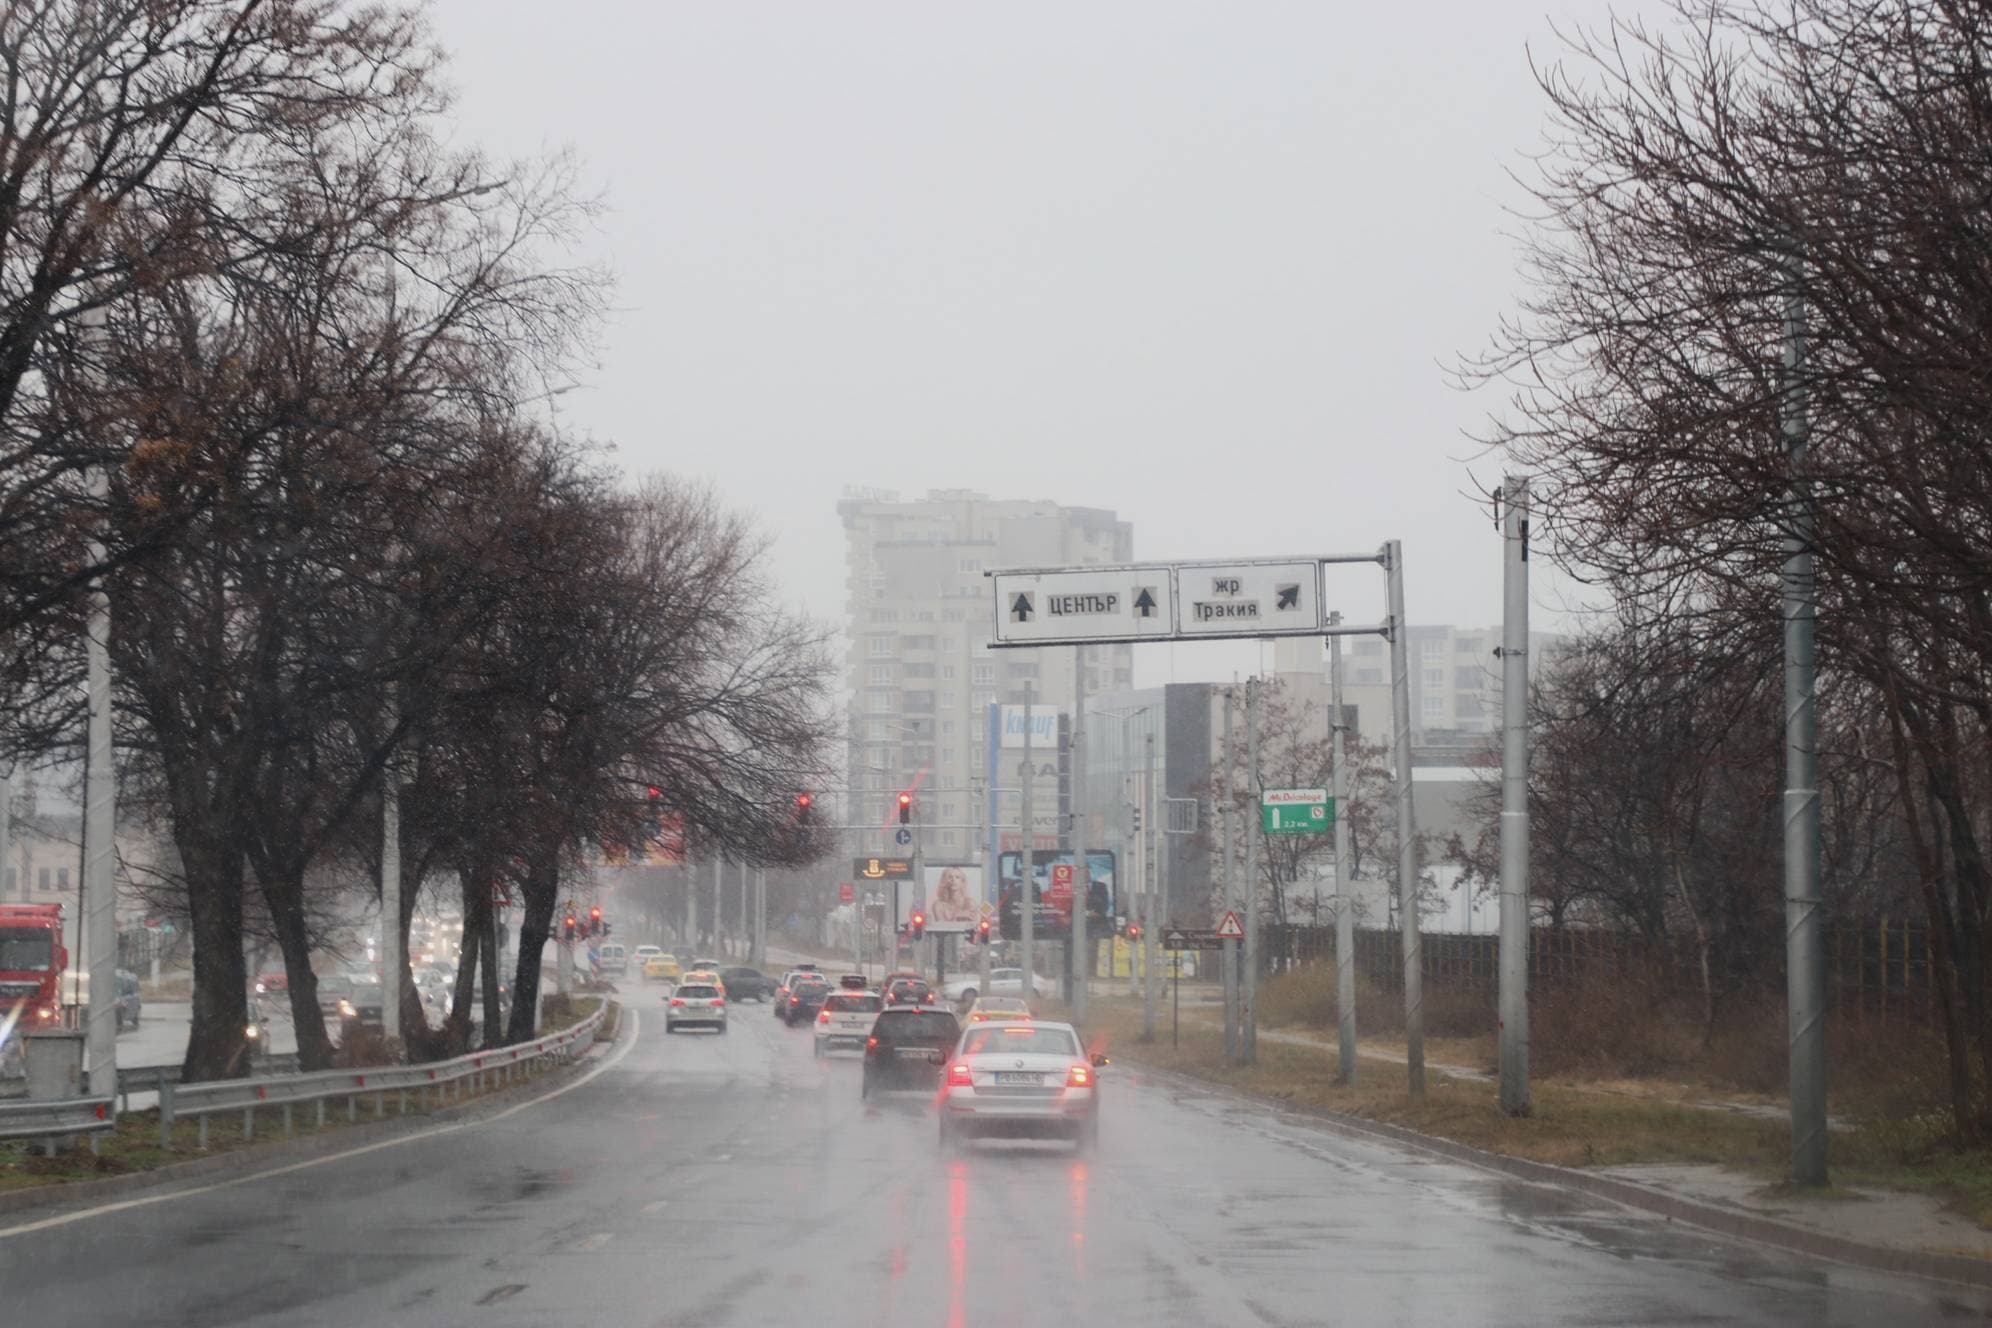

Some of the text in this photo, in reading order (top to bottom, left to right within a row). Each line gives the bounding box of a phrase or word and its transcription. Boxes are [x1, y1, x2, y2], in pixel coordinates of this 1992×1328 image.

[1215, 578, 1240, 596] жр
[1050, 595, 1117, 615] ЦЕНТЪР
[1193, 602, 1258, 622] Тракия
